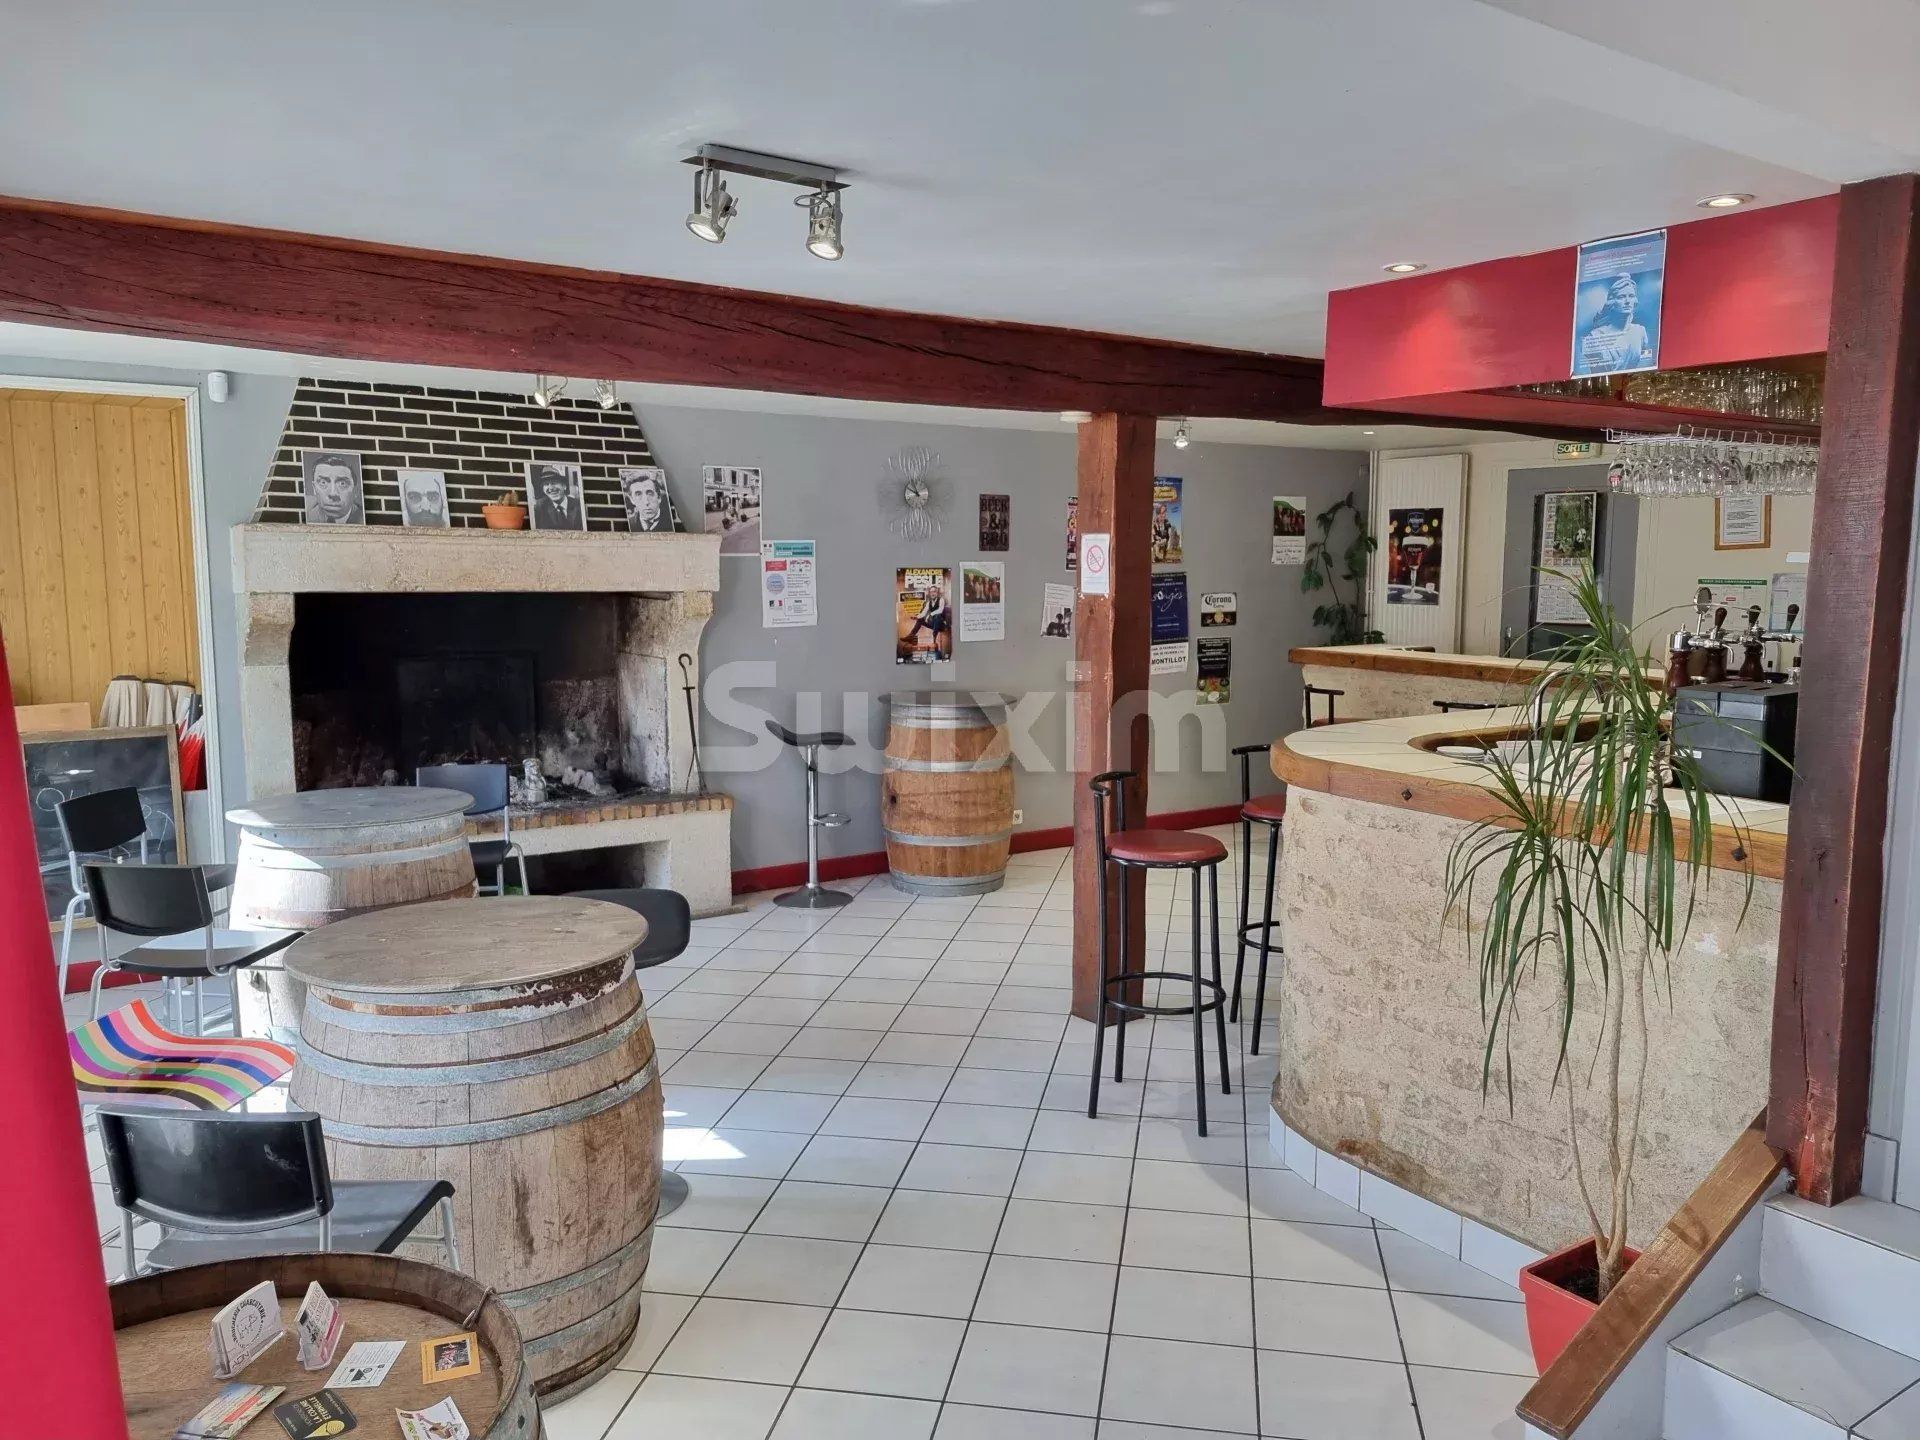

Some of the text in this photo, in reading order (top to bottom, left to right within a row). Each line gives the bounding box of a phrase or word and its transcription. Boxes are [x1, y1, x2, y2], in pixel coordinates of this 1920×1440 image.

[1558, 443, 1589, 453] SORTIE
[1204, 595, 1232, 605] Corona
[1151, 656, 1186, 664] MONTILLOT
